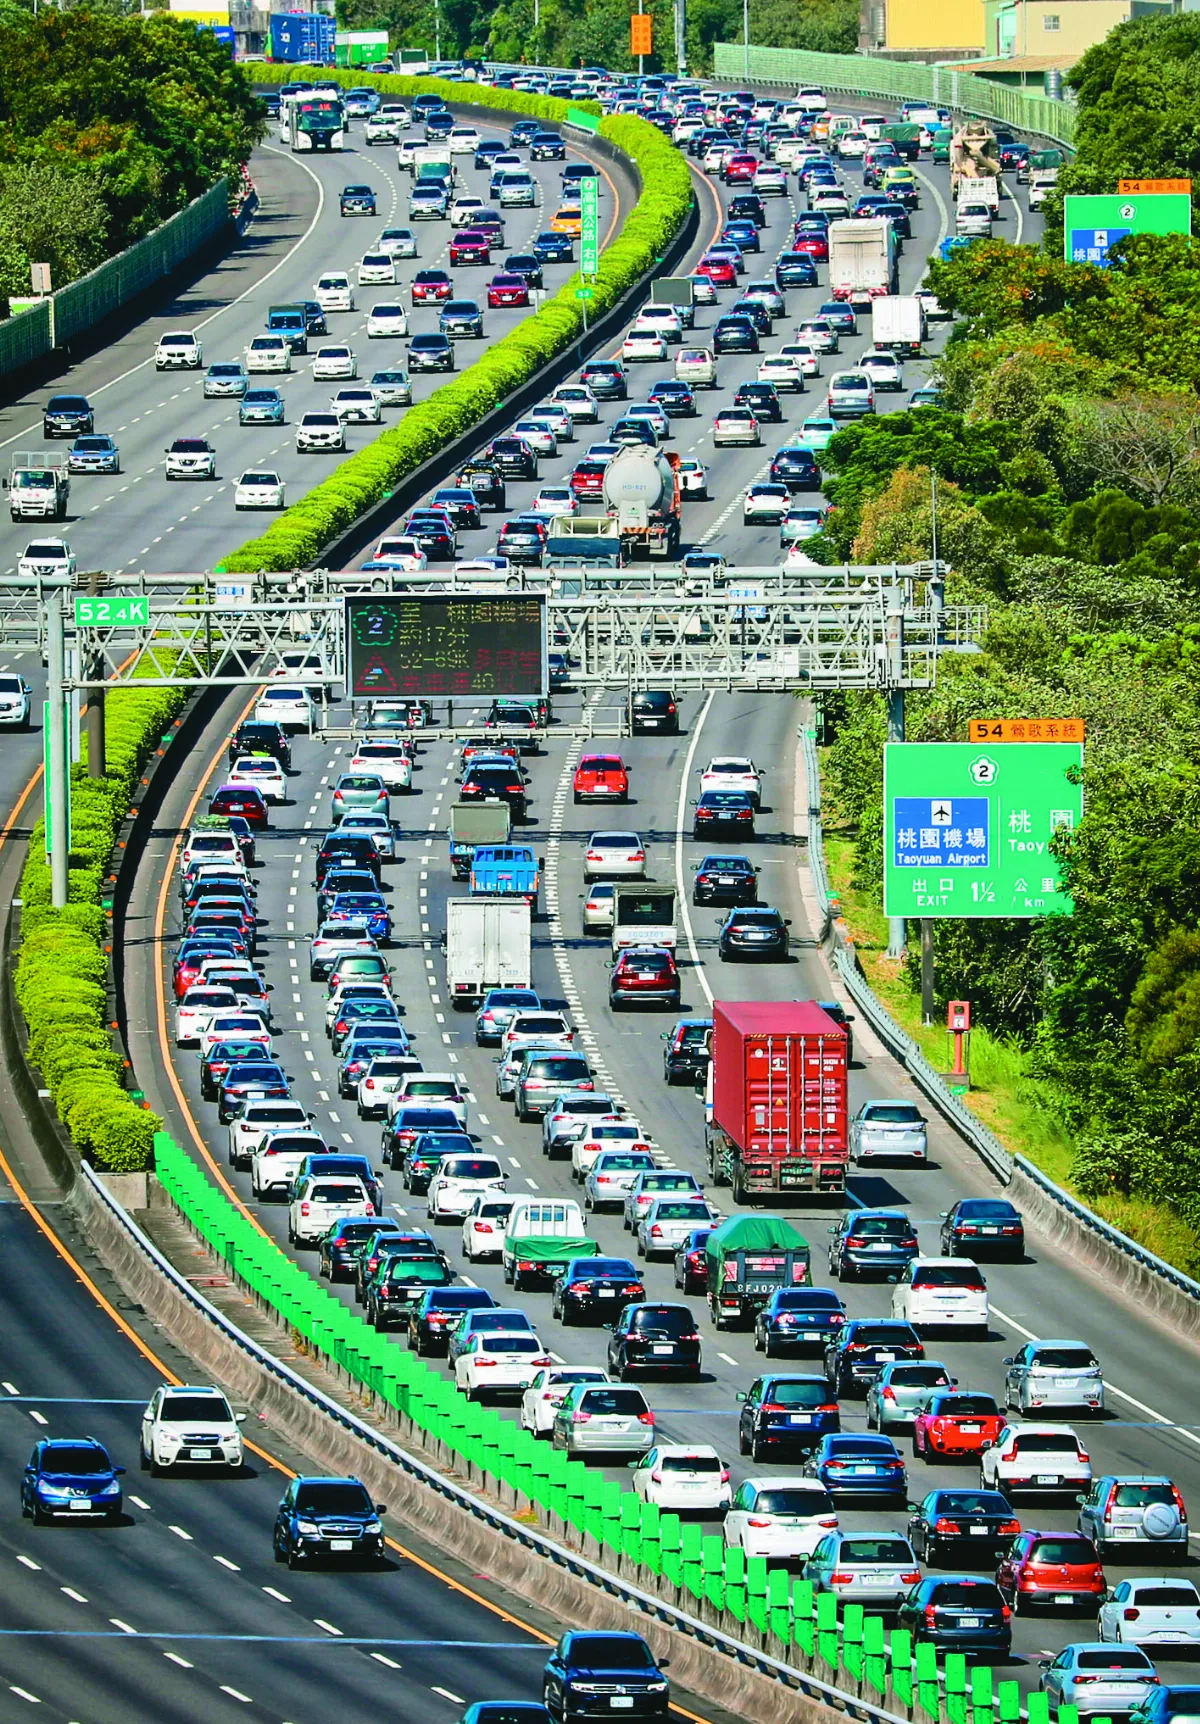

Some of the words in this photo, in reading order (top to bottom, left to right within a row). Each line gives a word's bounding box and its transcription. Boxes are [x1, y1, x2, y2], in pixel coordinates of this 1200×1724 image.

[1123, 182, 1140, 192] 54
[583, 192, 595, 241] 高速公路
[1124, 208, 1131, 216] 2
[583, 248, 595, 271] 右線
[79, 602, 145, 621] 52.4K
[368, 616, 383, 635] 2
[977, 724, 1004, 738] 54
[1010, 723, 1077, 738] 鶯歌系統
[979, 765, 989, 777] 2
[1008, 809, 1074, 834] 桃園
[897, 827, 986, 849] 桃園機場
[1008, 839, 1049, 855] Taoy
[897, 853, 942, 866] Taoyuan
[947, 853, 986, 866] Airport
[912, 878, 954, 892] 出口
[1014, 878, 1056, 892] 公里
[917, 896, 949, 906] EXIT
[1024, 897, 1045, 907] km
